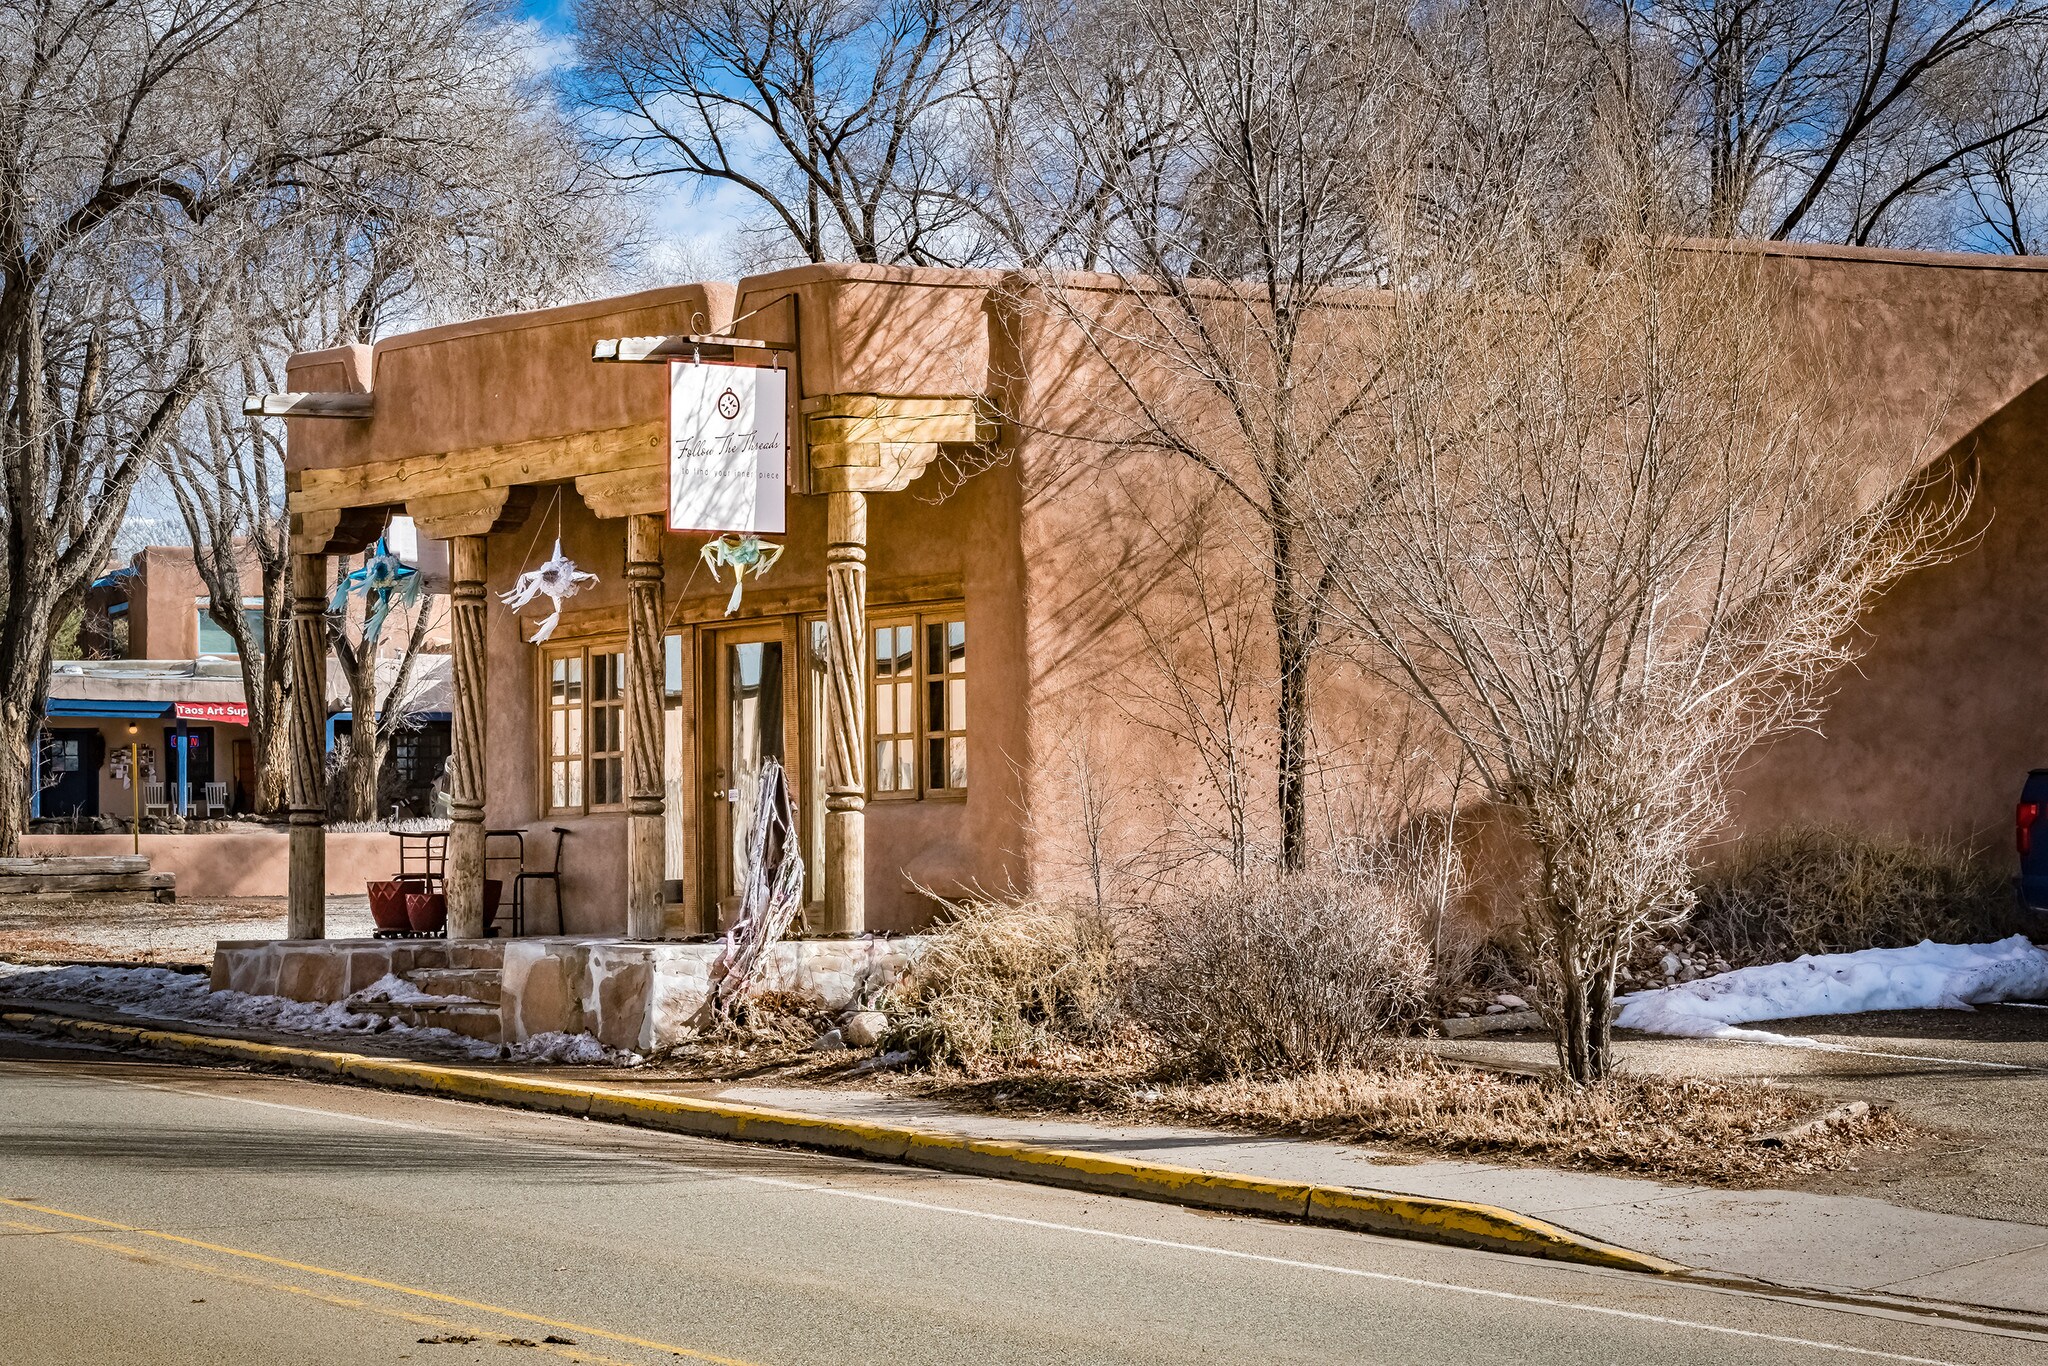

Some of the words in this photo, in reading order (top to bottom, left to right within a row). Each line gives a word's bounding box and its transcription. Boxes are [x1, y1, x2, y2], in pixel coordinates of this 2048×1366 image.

[676, 436, 714, 459] Follow
[715, 432, 738, 455] The
[738, 430, 781, 453] Threads
[734, 470, 754, 478] inner
[759, 472, 779, 480] piece
[177, 706, 204, 715] Taos
[206, 706, 224, 715] Art
[226, 706, 248, 717] Sup
